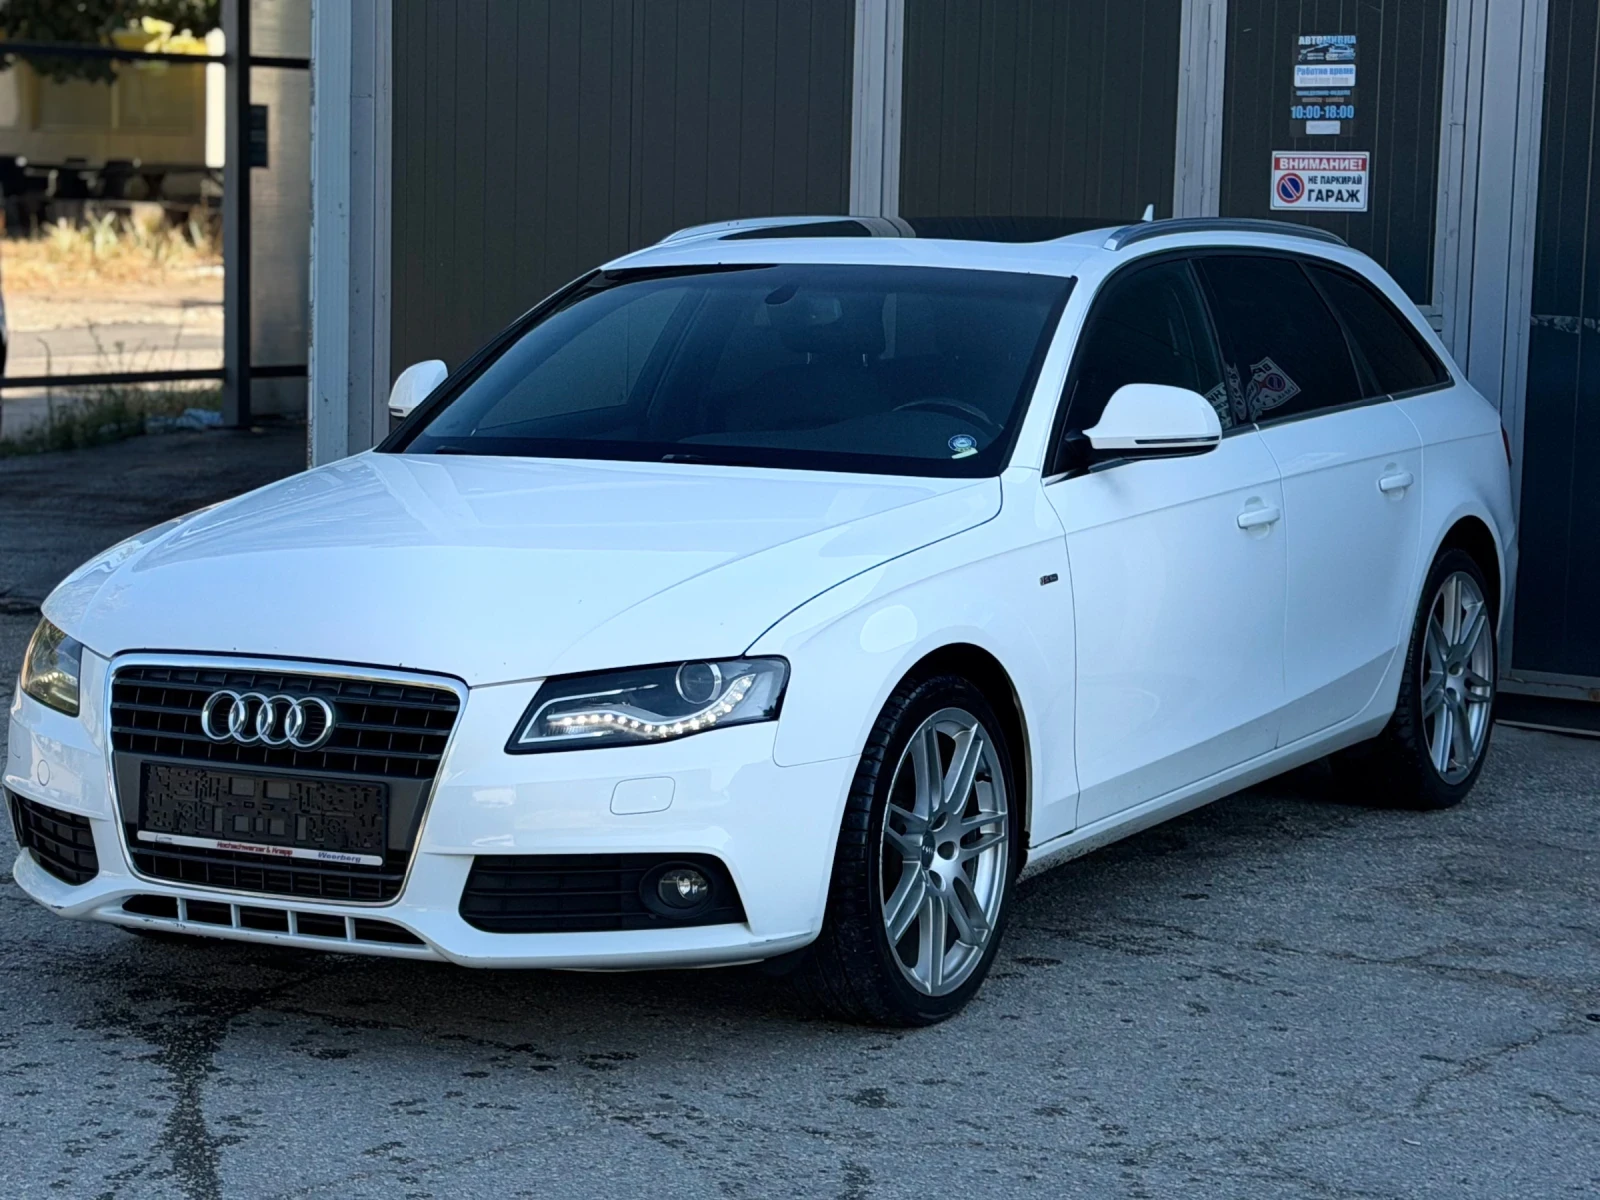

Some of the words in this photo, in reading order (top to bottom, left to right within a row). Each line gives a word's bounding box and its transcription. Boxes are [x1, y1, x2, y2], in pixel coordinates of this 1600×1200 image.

[1290, 105, 1355, 119] 10:00-18:00
[1279, 158, 1363, 171] ВНИМАНИЕ!
[1308, 176, 1318, 185] НЕ
[1320, 175, 1362, 185] ПАРКИРАЙ
[1307, 189, 1360, 203] ГАРАЖ
